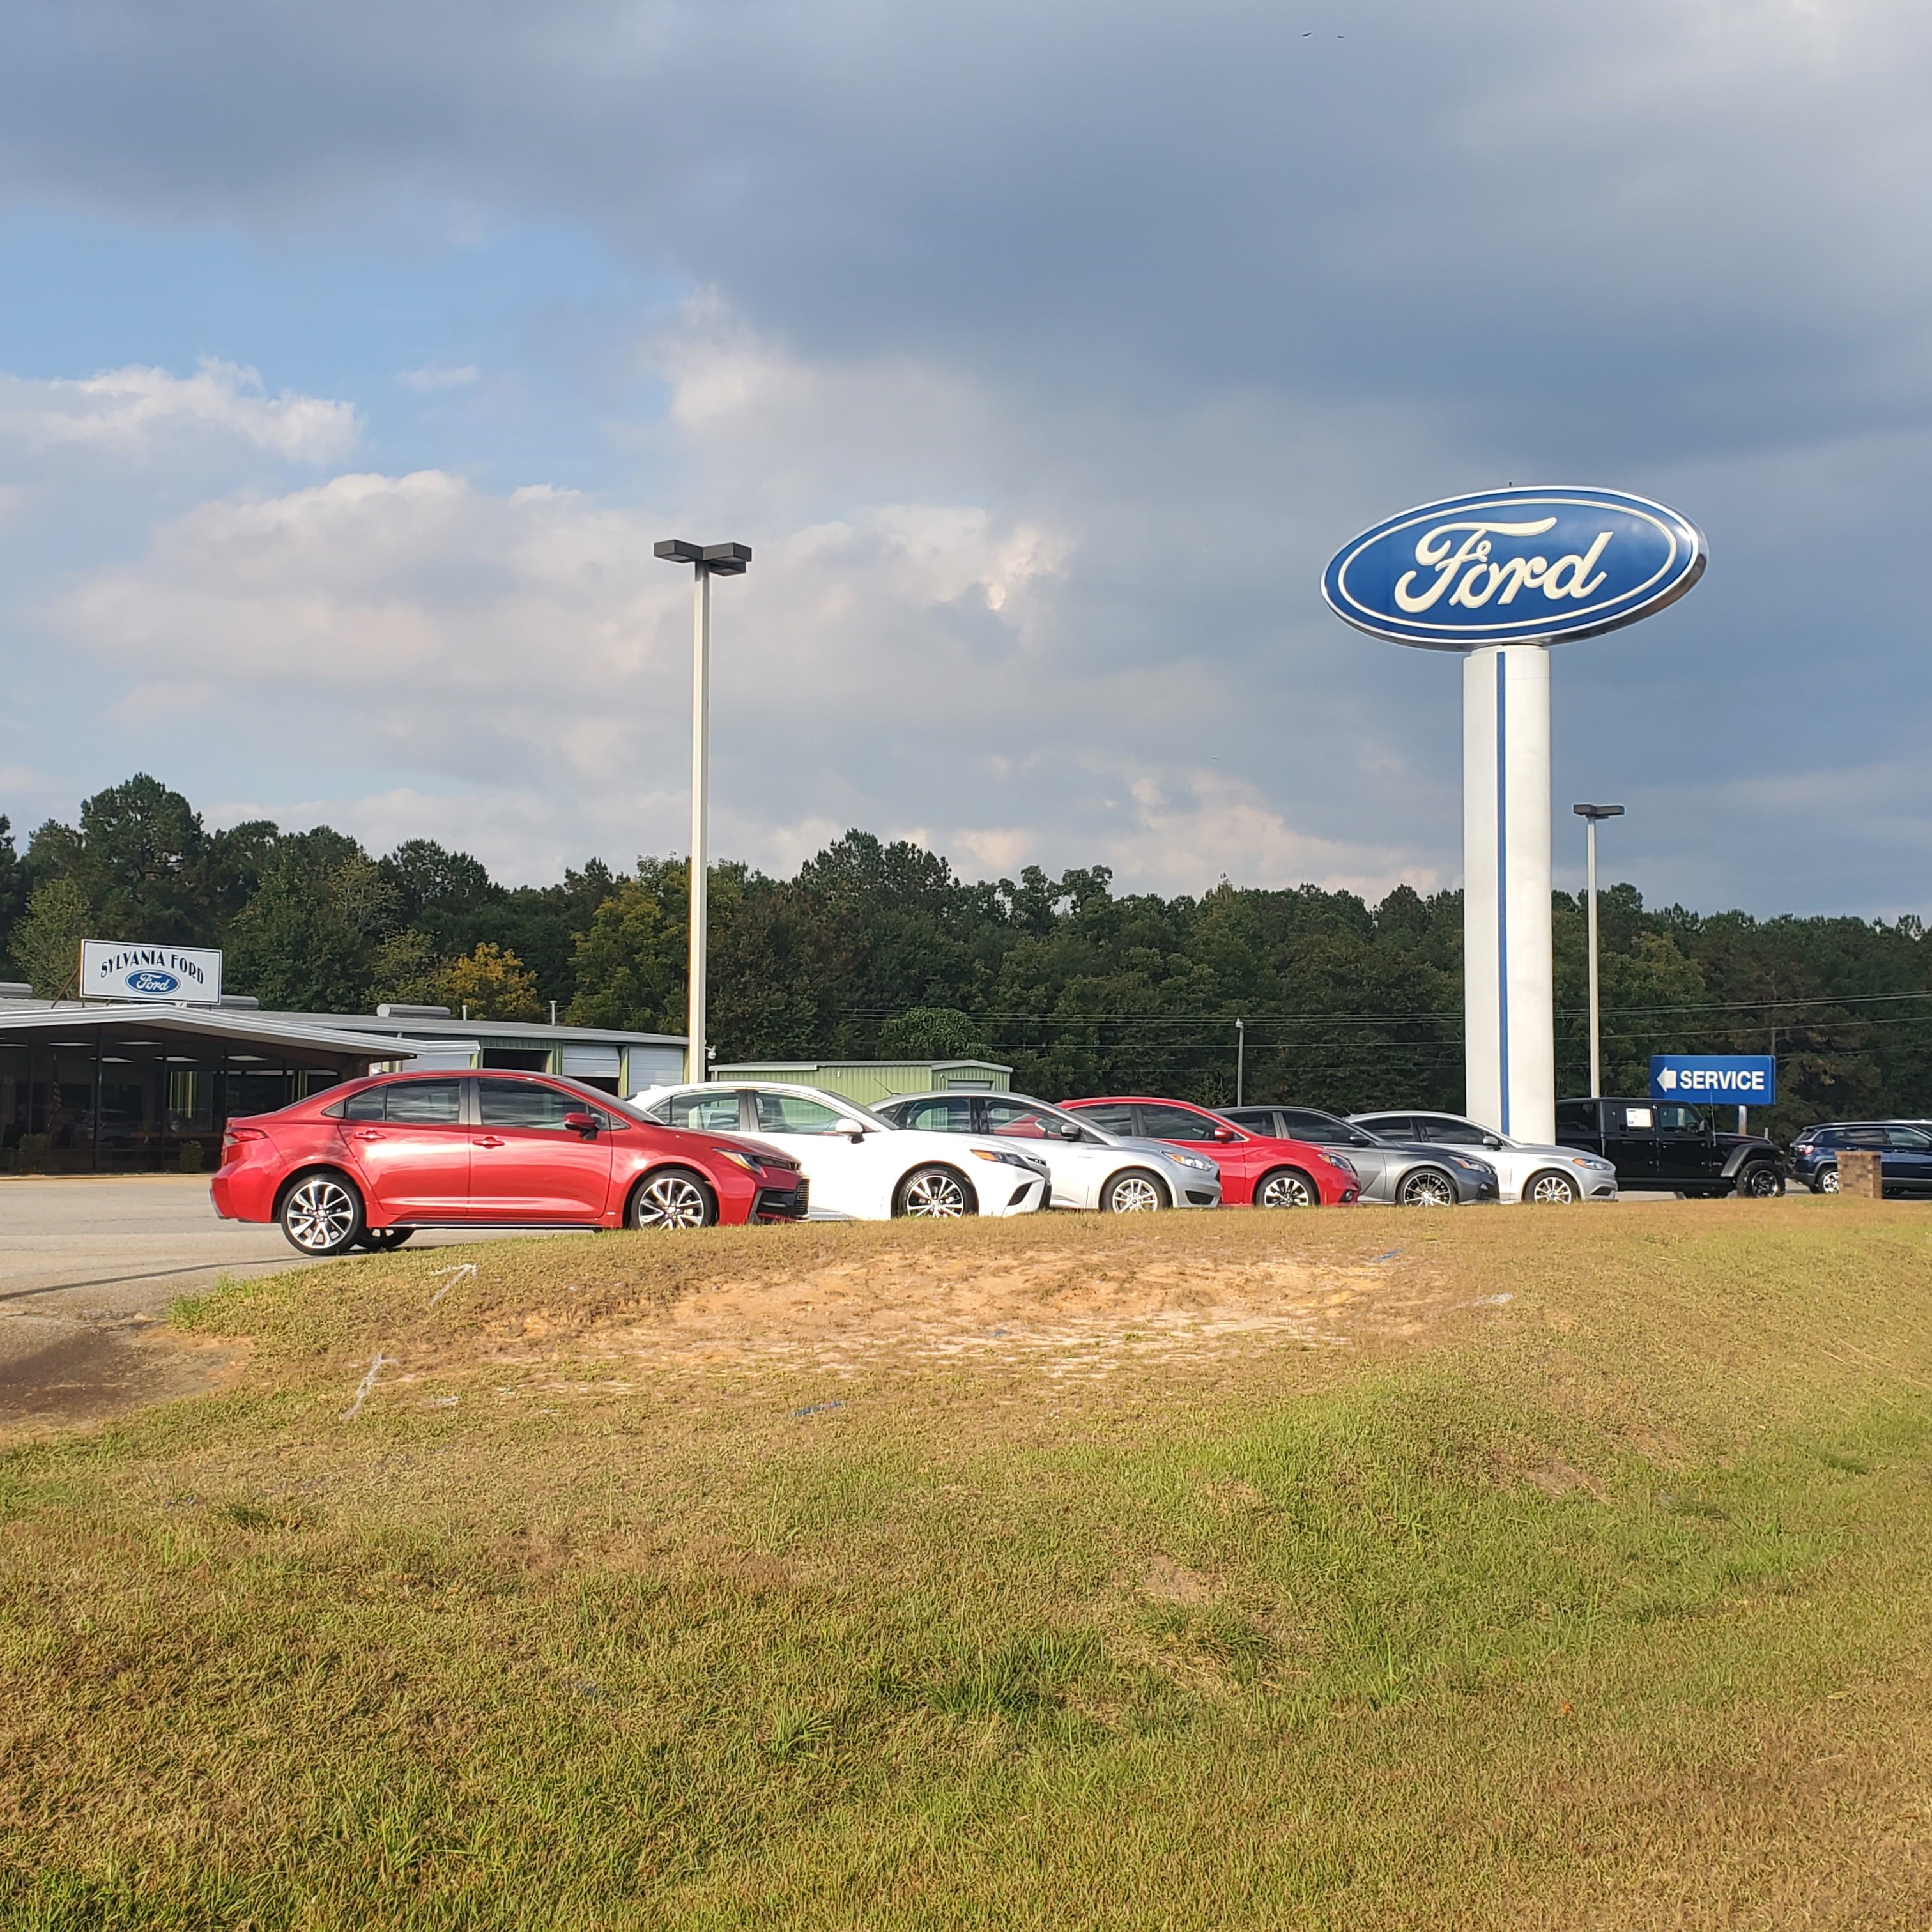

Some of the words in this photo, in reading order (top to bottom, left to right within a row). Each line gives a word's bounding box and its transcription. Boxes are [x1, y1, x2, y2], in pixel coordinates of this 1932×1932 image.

[1394, 517, 1613, 613] Ford
[100, 950, 165, 978] SYLVANIA
[171, 953, 204, 985] FORD
[136, 972, 170, 991] Ford
[1680, 1070, 1765, 1090] SERVICE
